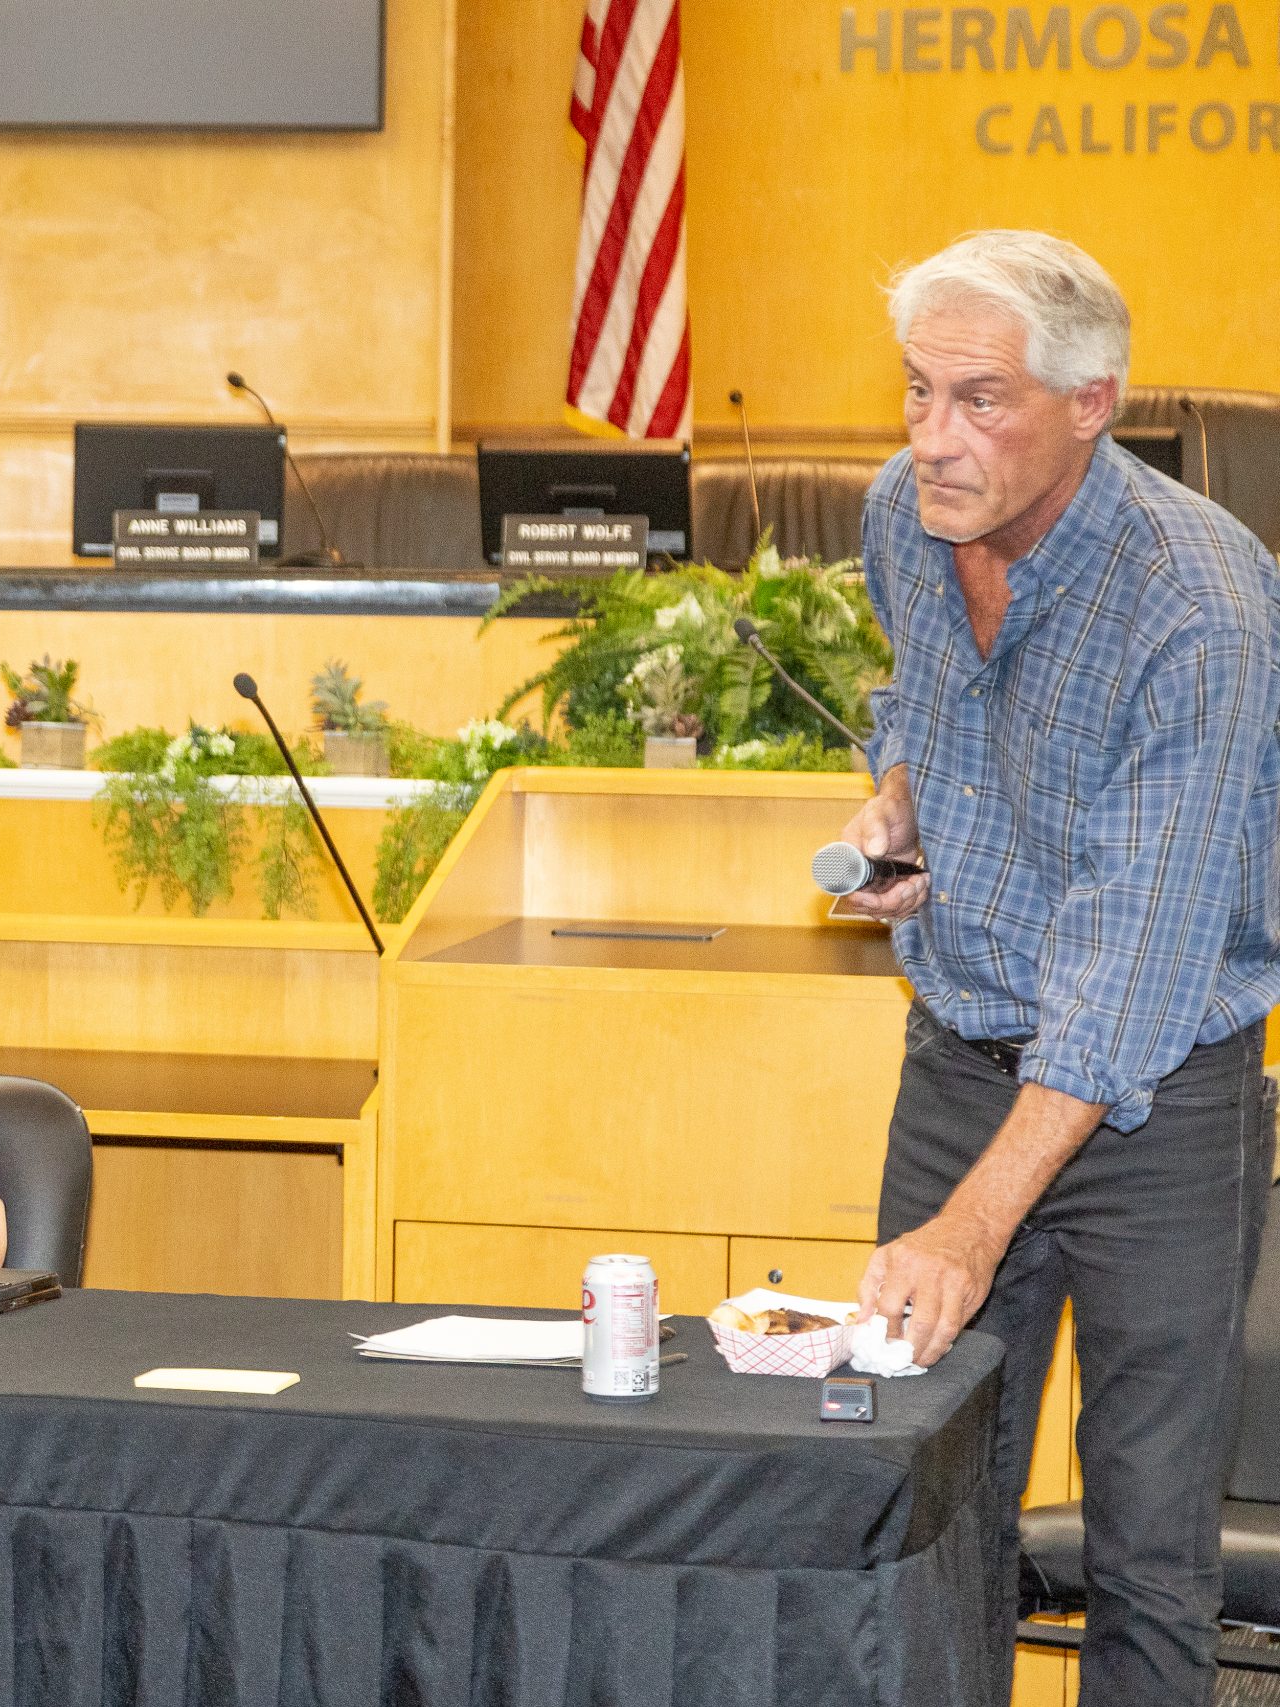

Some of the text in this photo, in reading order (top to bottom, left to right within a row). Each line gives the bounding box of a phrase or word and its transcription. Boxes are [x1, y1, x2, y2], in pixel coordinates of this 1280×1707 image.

[839, 3, 1251, 73] HERMOSA
[975, 100, 1280, 155] CALIFOR
[128, 518, 247, 536] ANNE WILLIAMS
[518, 523, 632, 542] ROBERT WOLFE
[118, 546, 250, 562] CIVIL SERVICE BOARD MEMBER
[507, 550, 639, 566] CIVIL SERVICE BOARD MEMBER
